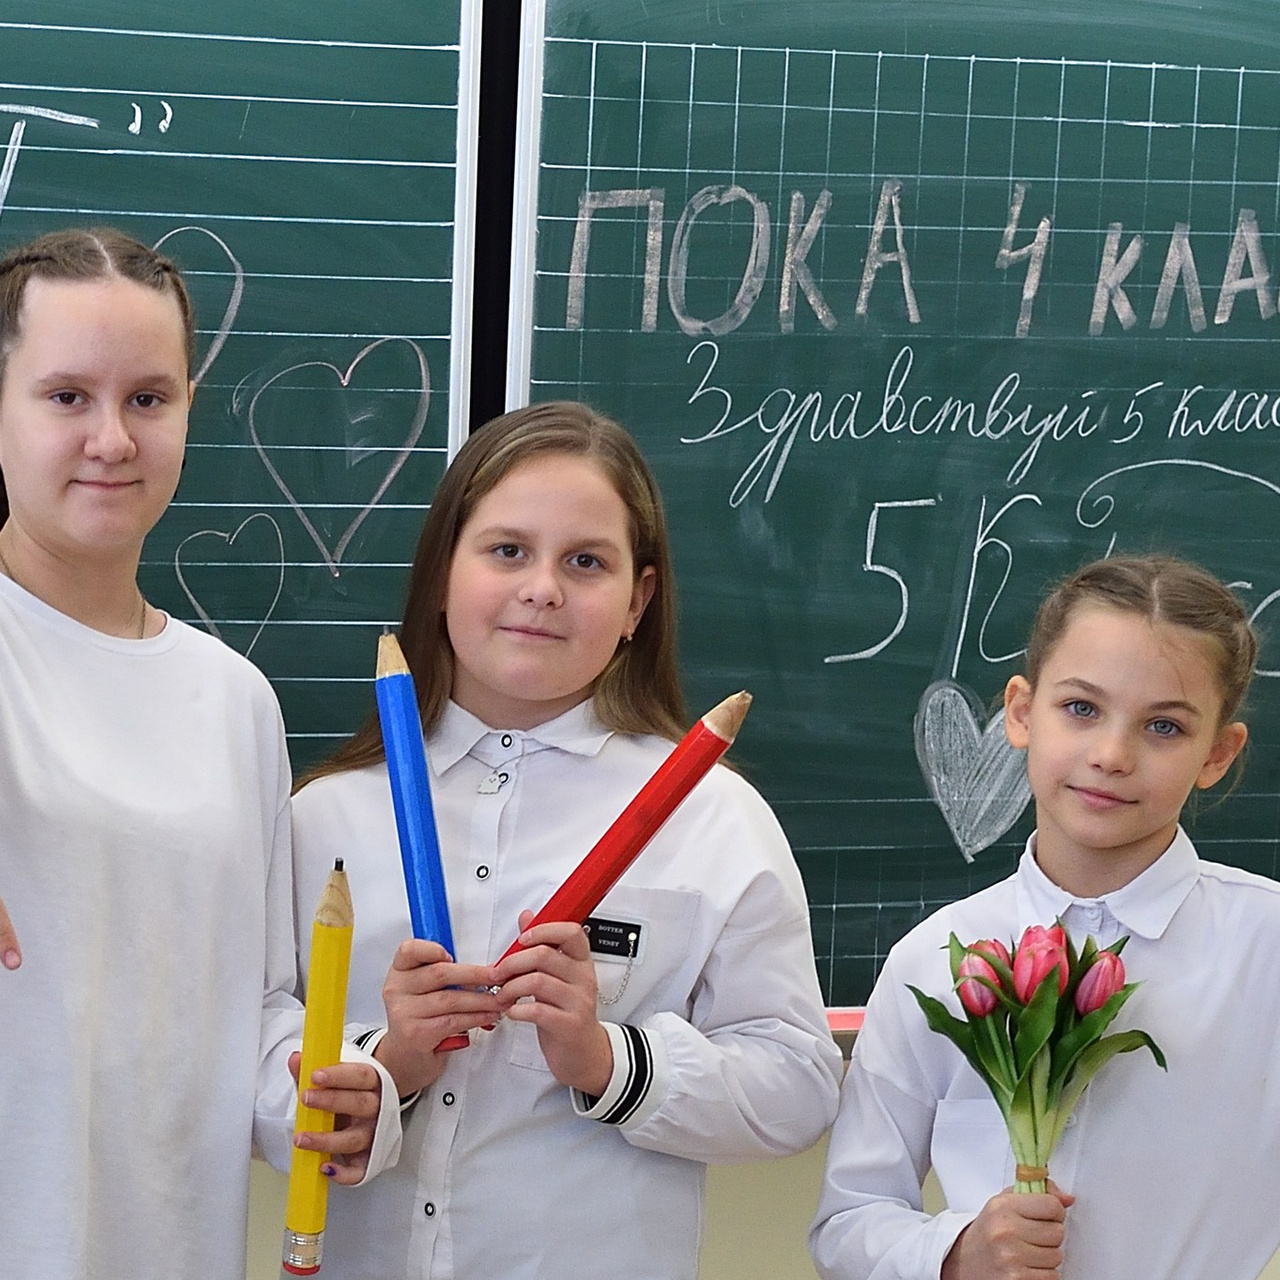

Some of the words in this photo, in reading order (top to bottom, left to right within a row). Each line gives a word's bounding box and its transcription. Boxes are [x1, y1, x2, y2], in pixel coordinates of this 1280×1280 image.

[565, 178, 922, 336] ПОКА
[995, 181, 1052, 338] 4
[1088, 208, 1280, 336] КЛА
[680, 340, 1098, 508] Здравствуй
[1111, 381, 1164, 444] 5
[824, 494, 943, 664] 5
